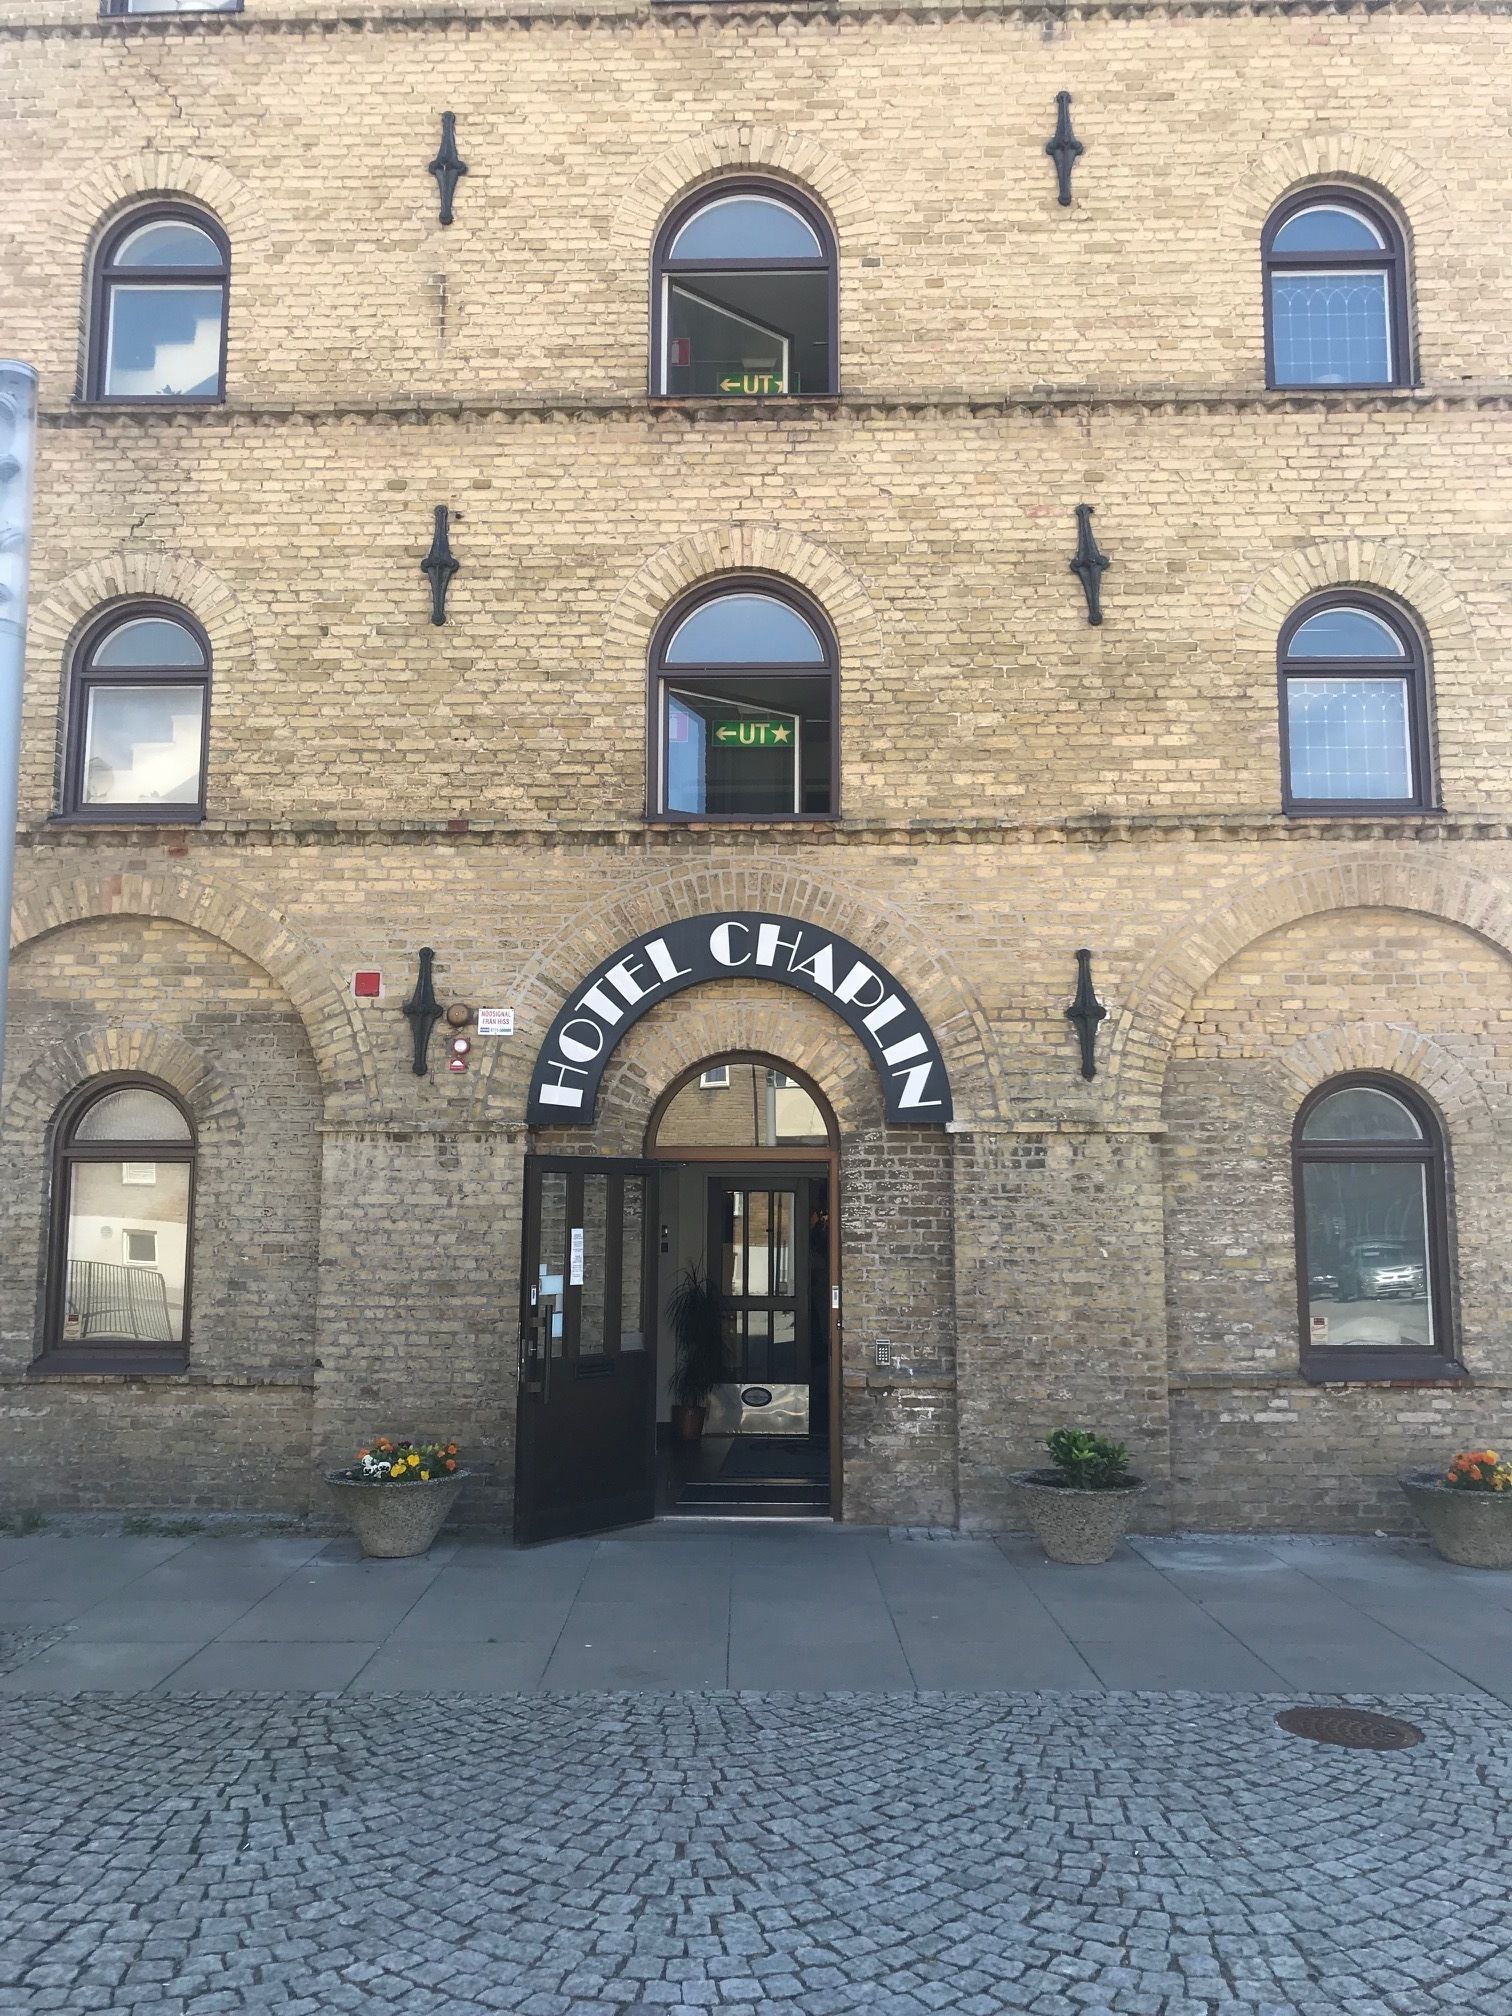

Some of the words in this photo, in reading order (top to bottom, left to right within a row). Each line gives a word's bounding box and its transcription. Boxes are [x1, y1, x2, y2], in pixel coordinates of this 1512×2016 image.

[743, 374, 774, 394] UT
[739, 722, 770, 744] UT
[538, 937, 693, 1108] HOTEL
[709, 921, 942, 1109] CHAPLIN
